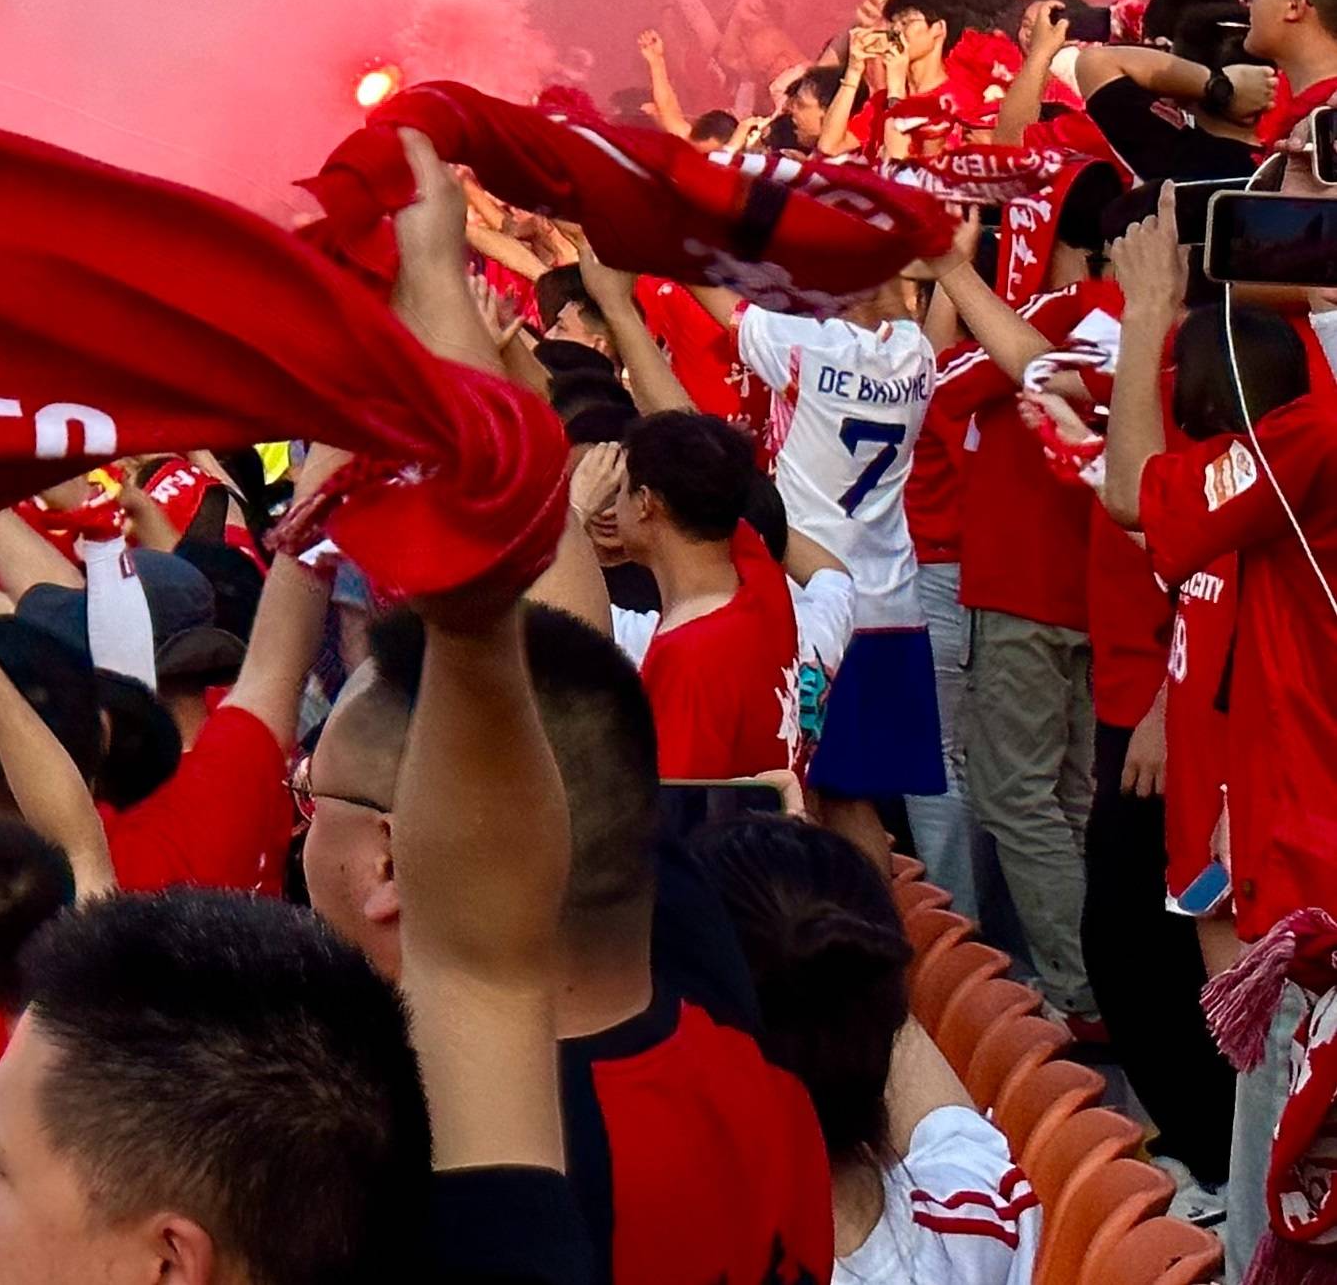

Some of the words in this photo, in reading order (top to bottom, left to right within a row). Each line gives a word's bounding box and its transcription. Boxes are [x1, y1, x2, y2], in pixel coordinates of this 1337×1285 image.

[817, 365, 854, 398] DE
[858, 373, 930, 404] BRUYNE
[838, 417, 907, 519] 7
